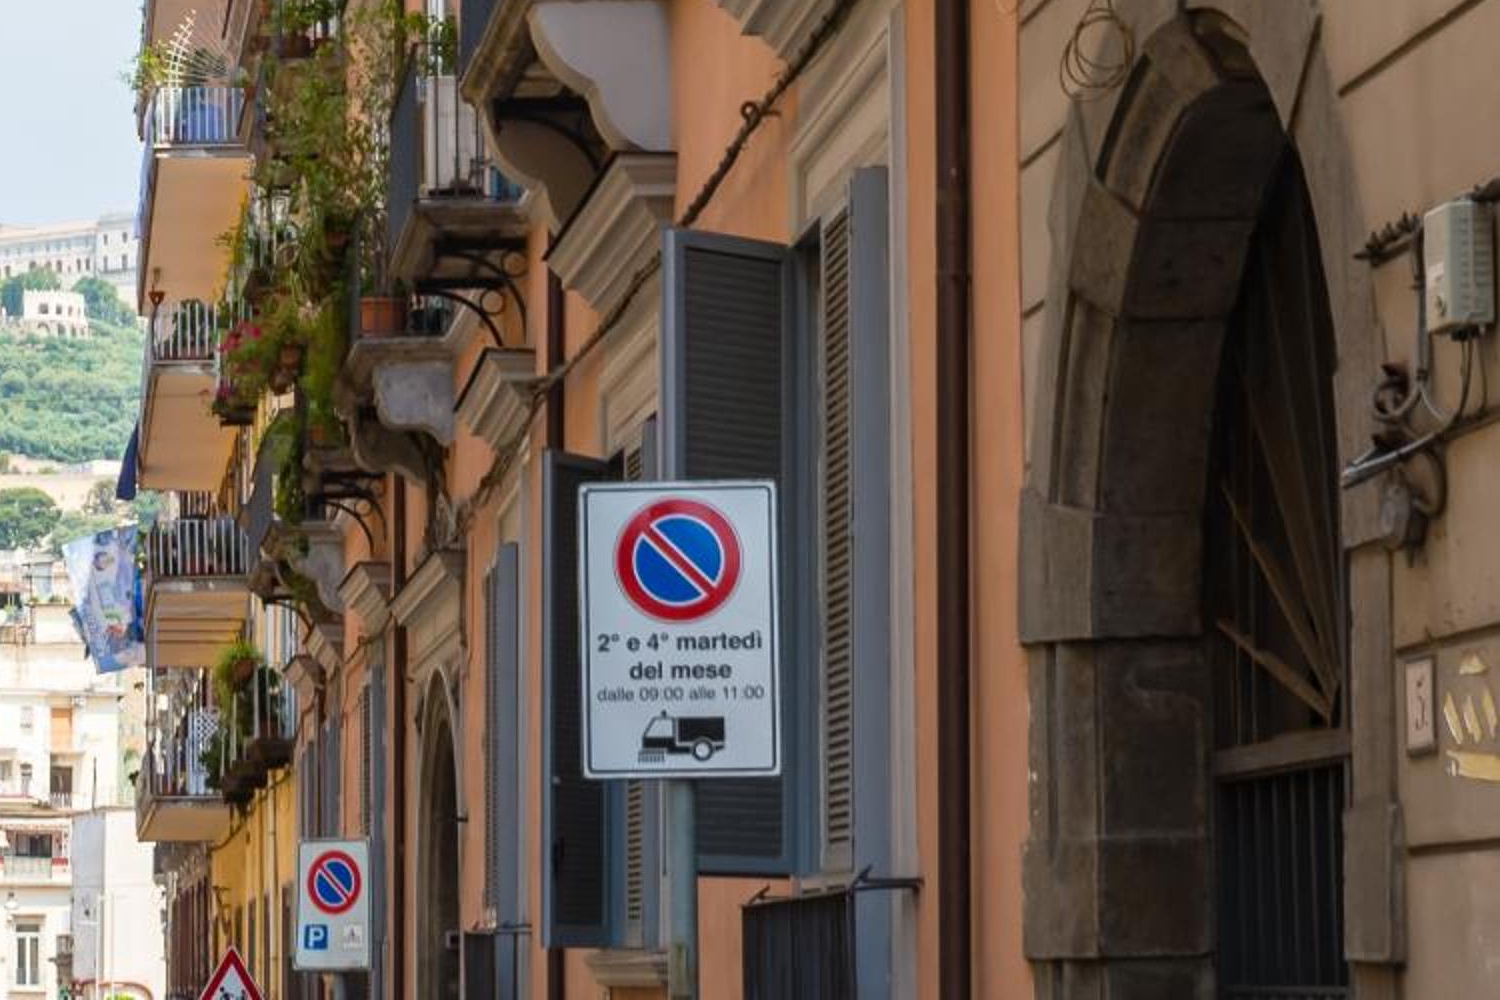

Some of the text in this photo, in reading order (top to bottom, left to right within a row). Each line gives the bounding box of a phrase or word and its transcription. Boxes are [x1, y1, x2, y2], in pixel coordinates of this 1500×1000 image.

[626, 636, 641, 651] e
[676, 630, 763, 650] martedì
[629, 661, 732, 680] del mese
[597, 686, 635, 701] dalle
[689, 685, 716, 700] alle
[308, 926, 325, 949] P
